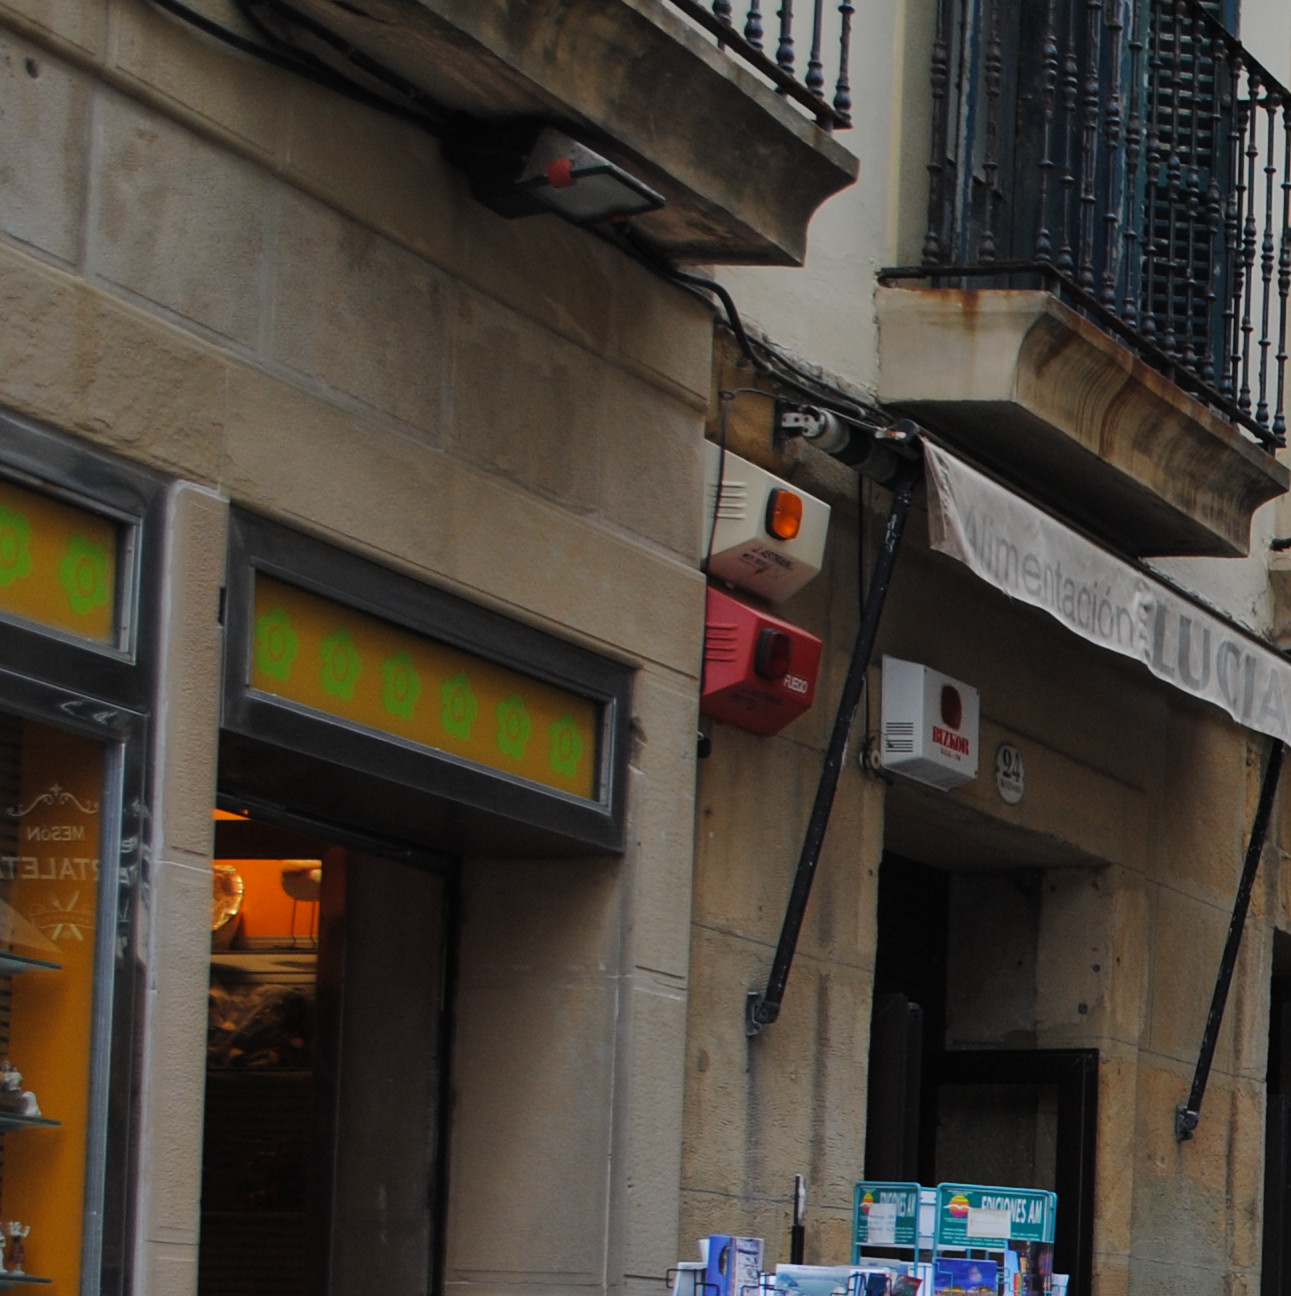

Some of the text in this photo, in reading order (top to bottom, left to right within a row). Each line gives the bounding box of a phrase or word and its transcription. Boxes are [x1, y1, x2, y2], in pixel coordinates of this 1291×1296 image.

[965, 504, 1134, 648] Alimentación
[1152, 600, 1287, 736] LUCIA
[783, 674, 808, 693] FUEGO
[932, 726, 969, 755] BIZKOR
[1028, 1200, 1044, 1224] AM
